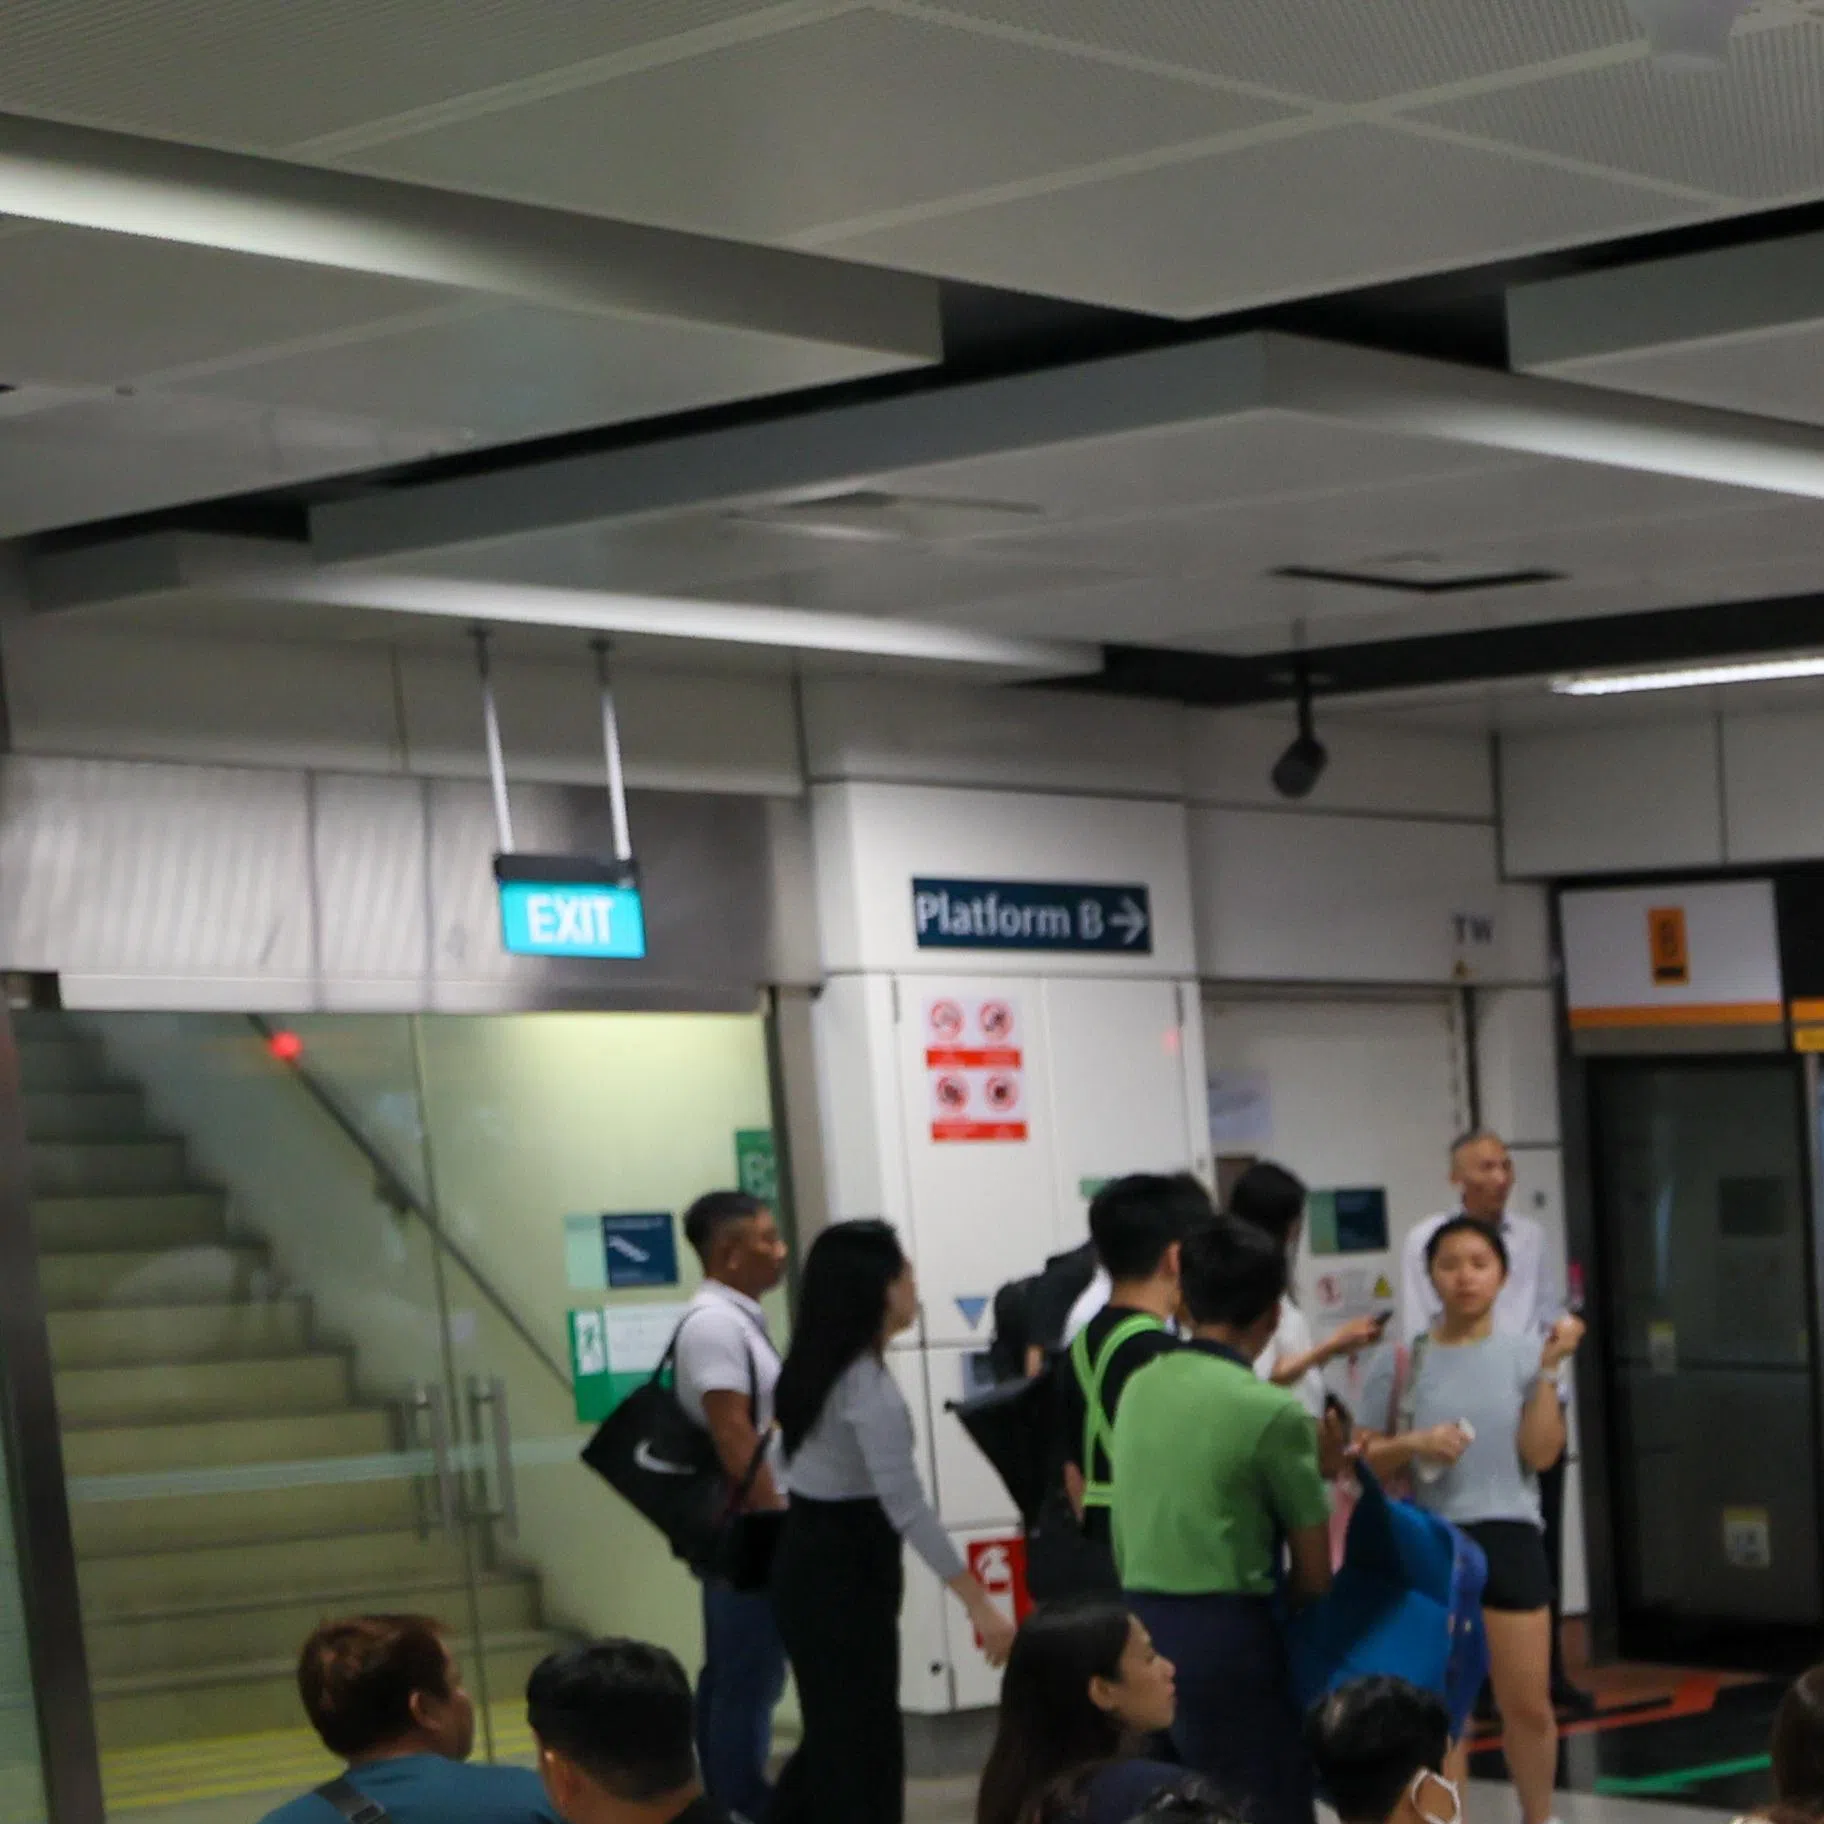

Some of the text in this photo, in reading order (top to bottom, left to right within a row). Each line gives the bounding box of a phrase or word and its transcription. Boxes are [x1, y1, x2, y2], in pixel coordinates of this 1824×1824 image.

[526, 893, 615, 945] EXIT
[916, 889, 1105, 940] Platform B
